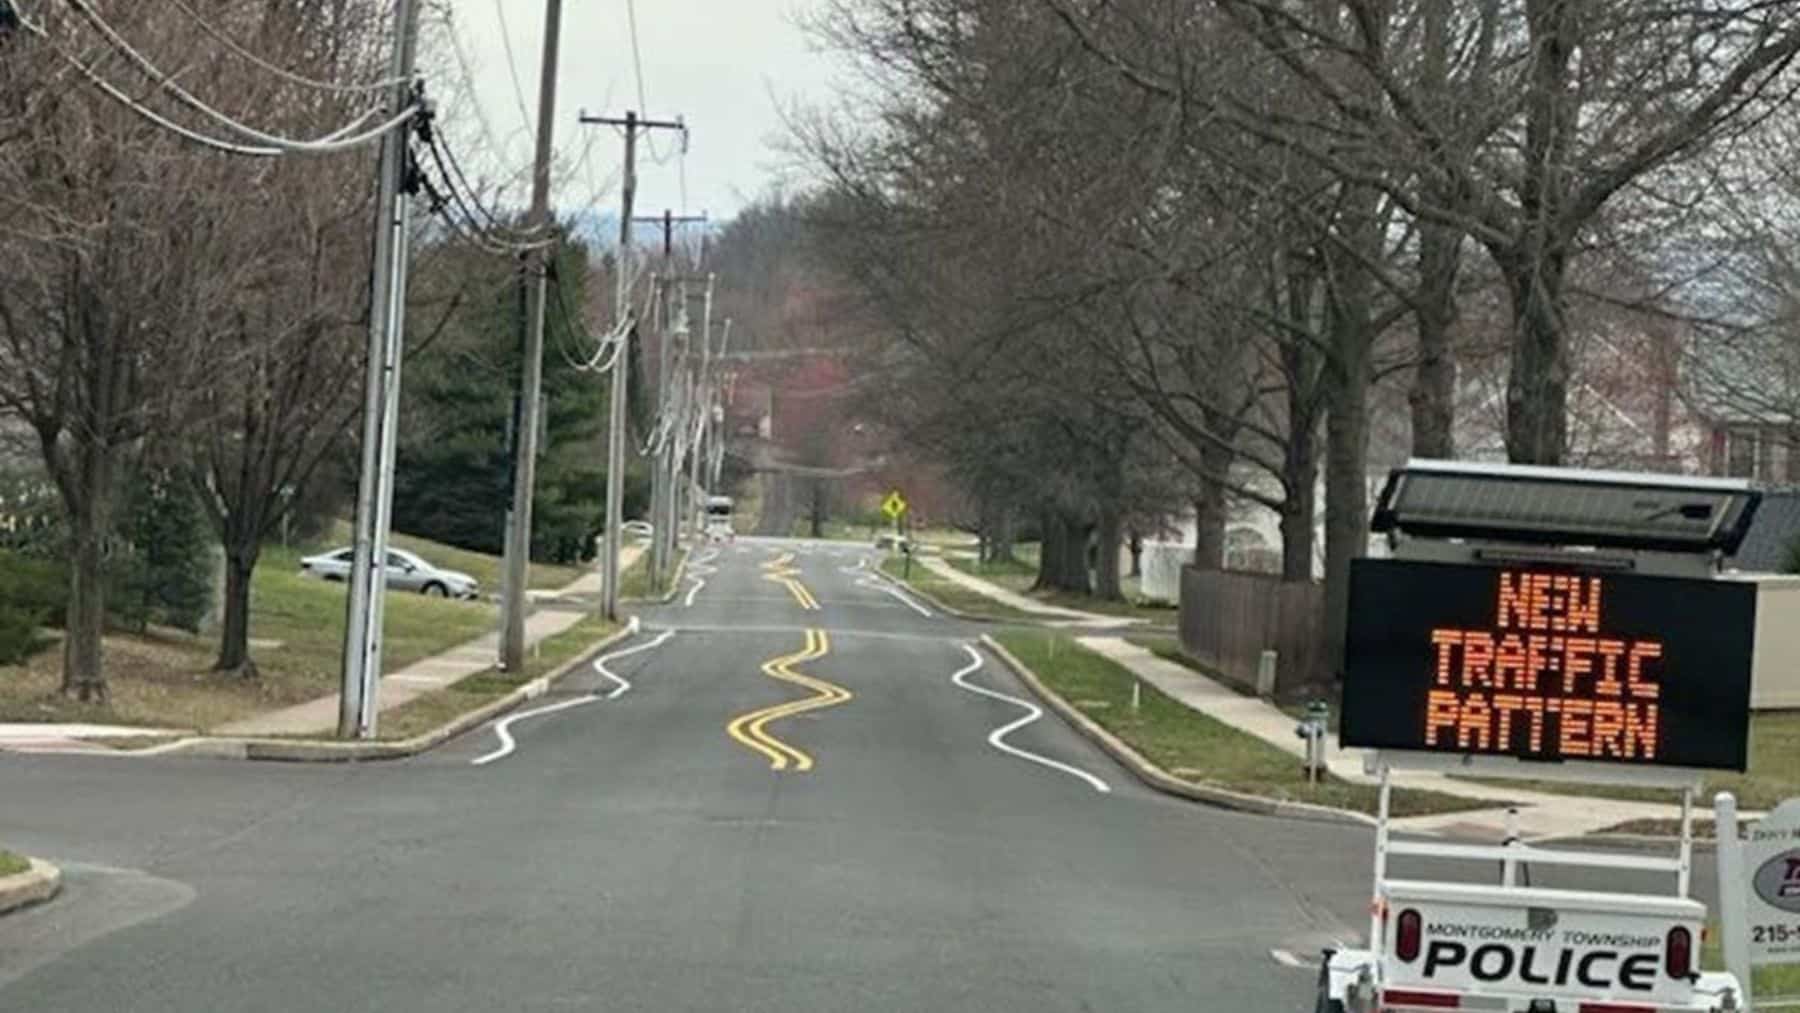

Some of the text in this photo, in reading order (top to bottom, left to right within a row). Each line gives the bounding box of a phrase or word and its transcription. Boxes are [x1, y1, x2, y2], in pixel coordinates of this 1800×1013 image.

[1498, 573, 1600, 632] NEW
[1431, 629, 1661, 698] TRAFFIC
[1425, 690, 1657, 758] PATTERN
[1426, 922, 1661, 948] MONTGOMERY TOWNSHIP
[1423, 940, 1660, 991] POLICE
